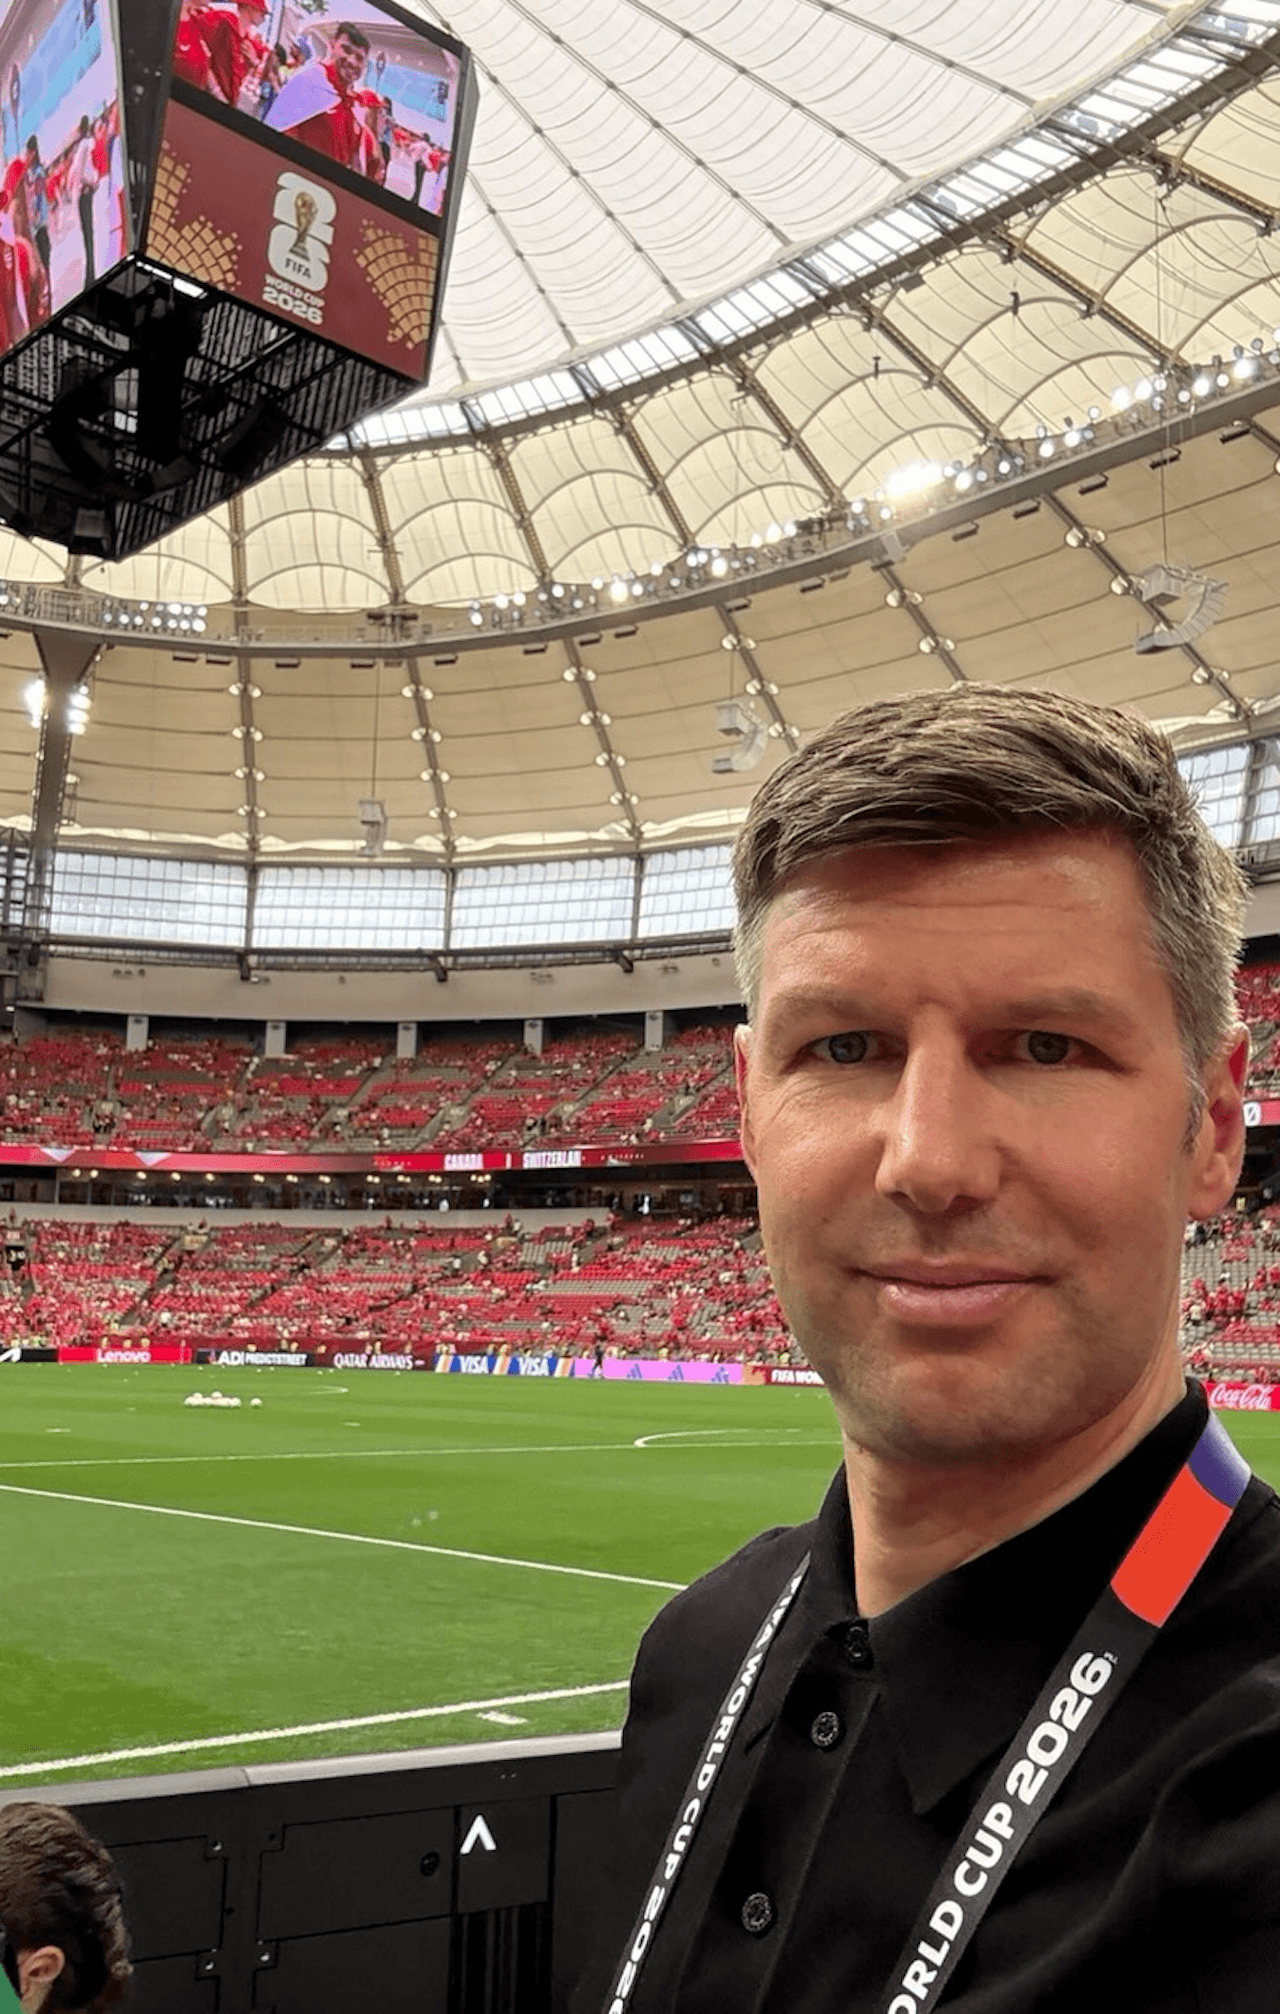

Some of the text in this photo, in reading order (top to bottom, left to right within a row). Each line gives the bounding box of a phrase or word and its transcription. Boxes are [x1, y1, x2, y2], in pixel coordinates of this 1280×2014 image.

[284, 257, 312, 279] FIFA
[265, 273, 303, 299] WORLD
[262, 286, 324, 325] 2026
[97, 1348, 150, 1363] Lenovo
[333, 1352, 368, 1369] QATAR
[459, 1355, 489, 1374] VISA
[519, 1357, 550, 1376] VISA
[697, 1652, 763, 1791] WORLD
[954, 1801, 1014, 1897] CUP
[1005, 1651, 1113, 1806] 2026
[664, 1798, 700, 1880] CUP
